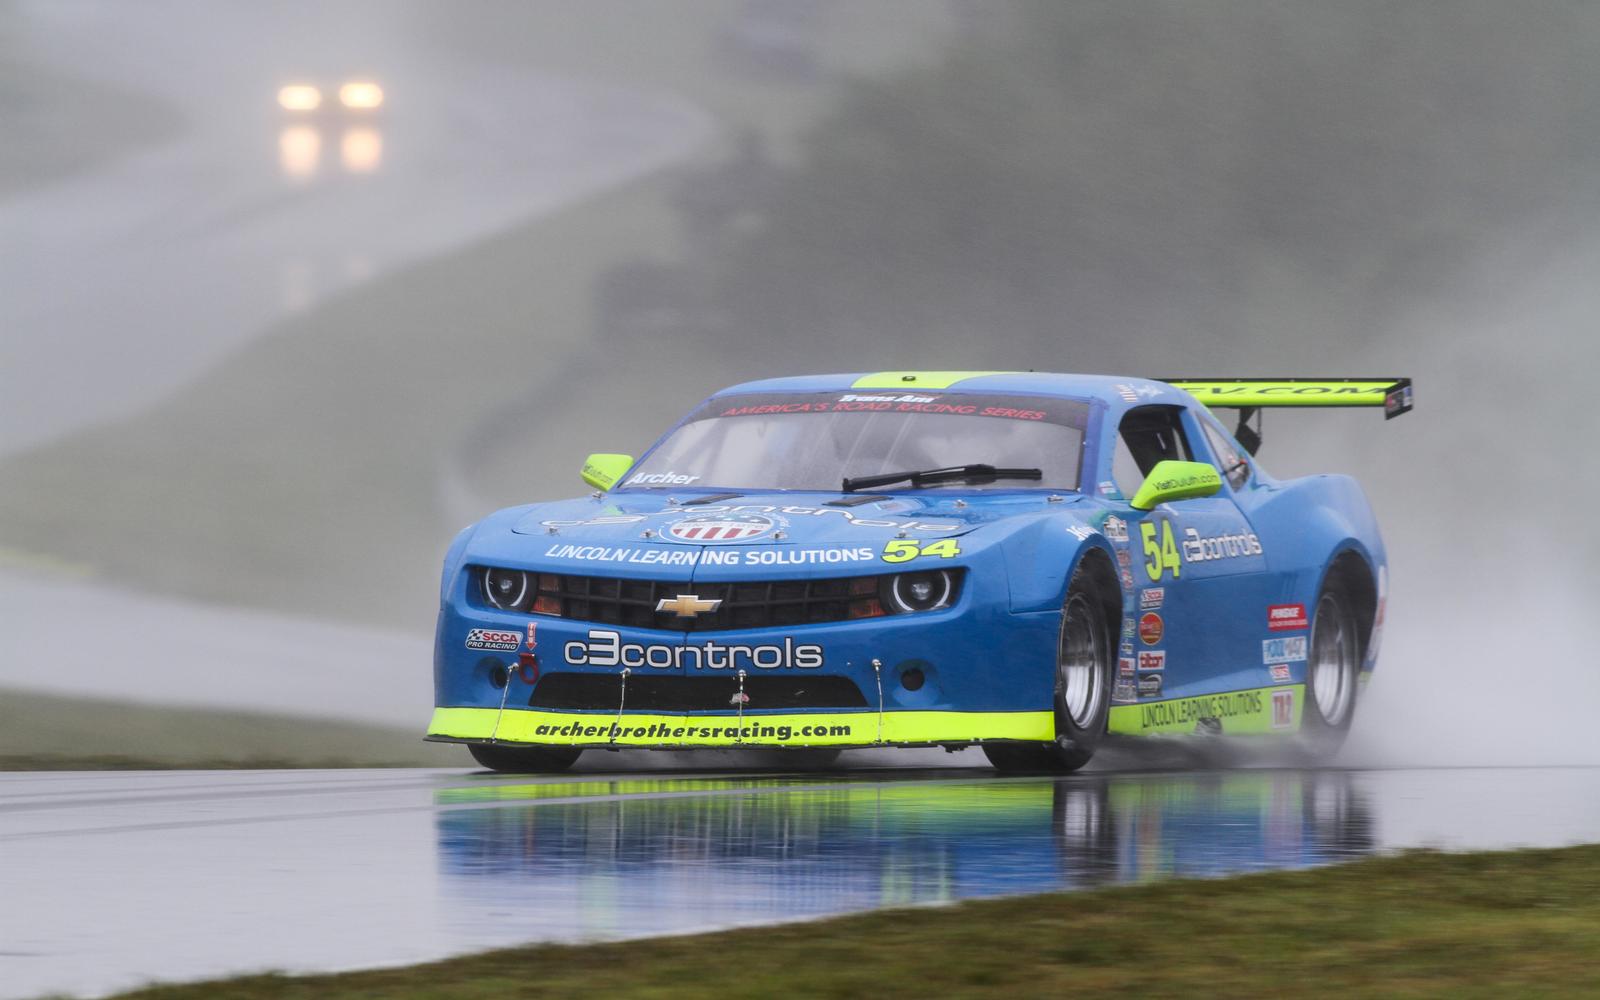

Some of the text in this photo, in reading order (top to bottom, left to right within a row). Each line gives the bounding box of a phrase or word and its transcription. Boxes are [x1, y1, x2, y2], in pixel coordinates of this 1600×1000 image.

[720, 402, 1047, 420] AMERICA'S ROAD RACING SERIES
[625, 471, 700, 486] Archer
[545, 543, 875, 566] LINCOLN LEARNING SOLUTIONS
[880, 538, 961, 564] 54
[1140, 518, 1181, 582] 54
[467, 640, 517, 650] PRO RACING
[482, 632, 518, 643] SCCA
[564, 629, 824, 669] c3controls
[1142, 703, 1176, 728] LINCOLN
[535, 721, 851, 741] archerbrothersracing.com
